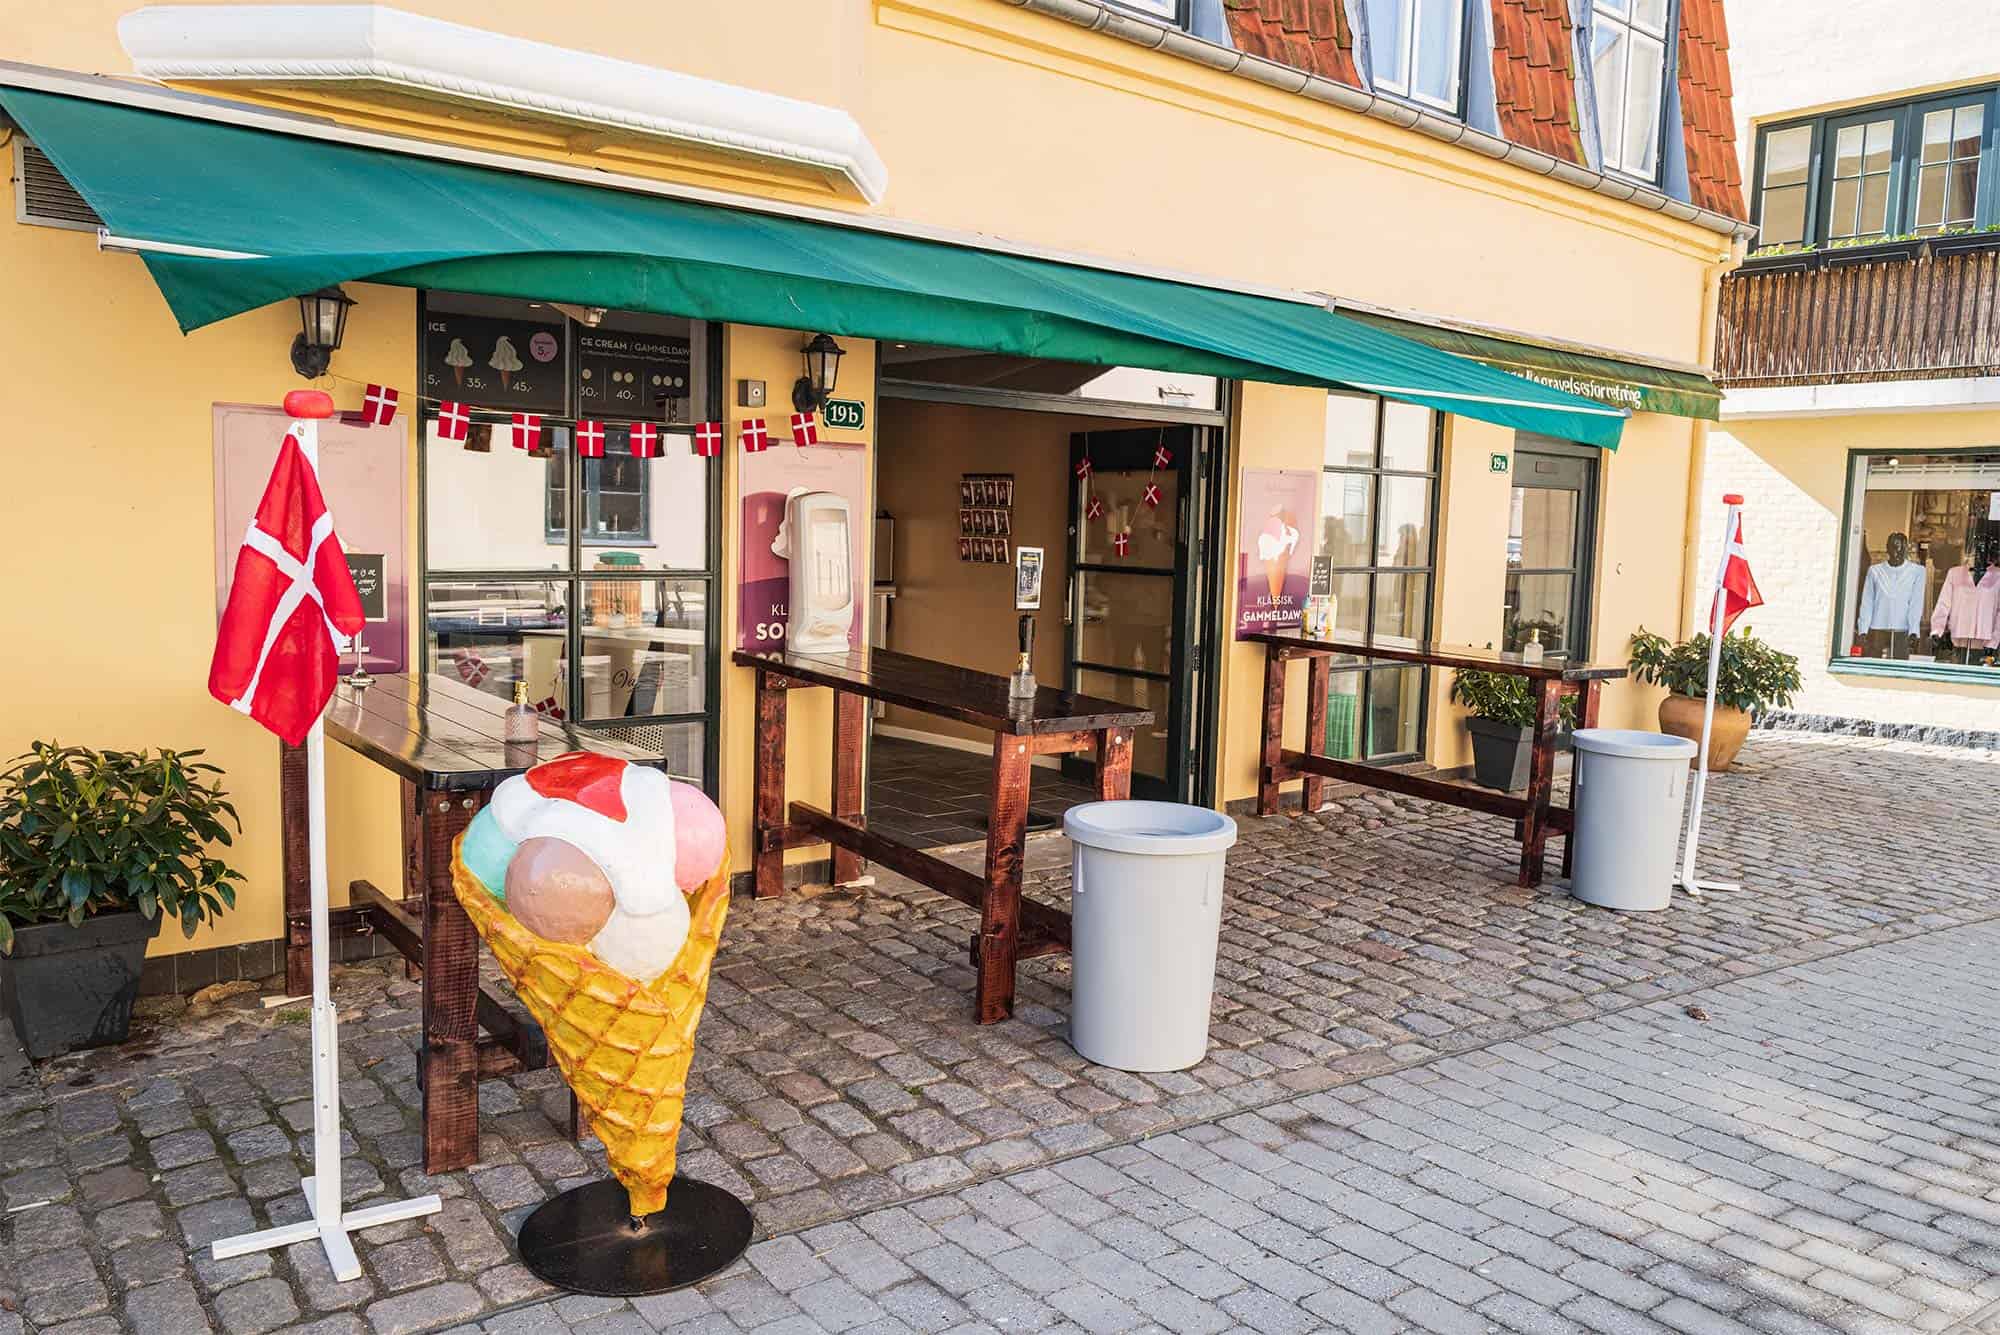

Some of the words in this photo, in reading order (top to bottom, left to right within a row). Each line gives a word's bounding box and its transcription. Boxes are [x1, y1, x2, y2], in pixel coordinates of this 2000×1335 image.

[428, 321, 447, 332] ICE
[580, 337, 593, 347] CE
[595, 339, 627, 351] CREAM
[424, 374, 440, 386] 5,-
[830, 404, 859, 423] 19b
[1257, 595, 1293, 606] KLASSISK
[771, 604, 787, 617] KL
[1243, 609, 1302, 622] GAMMELDAW
[756, 622, 788, 640] SO
